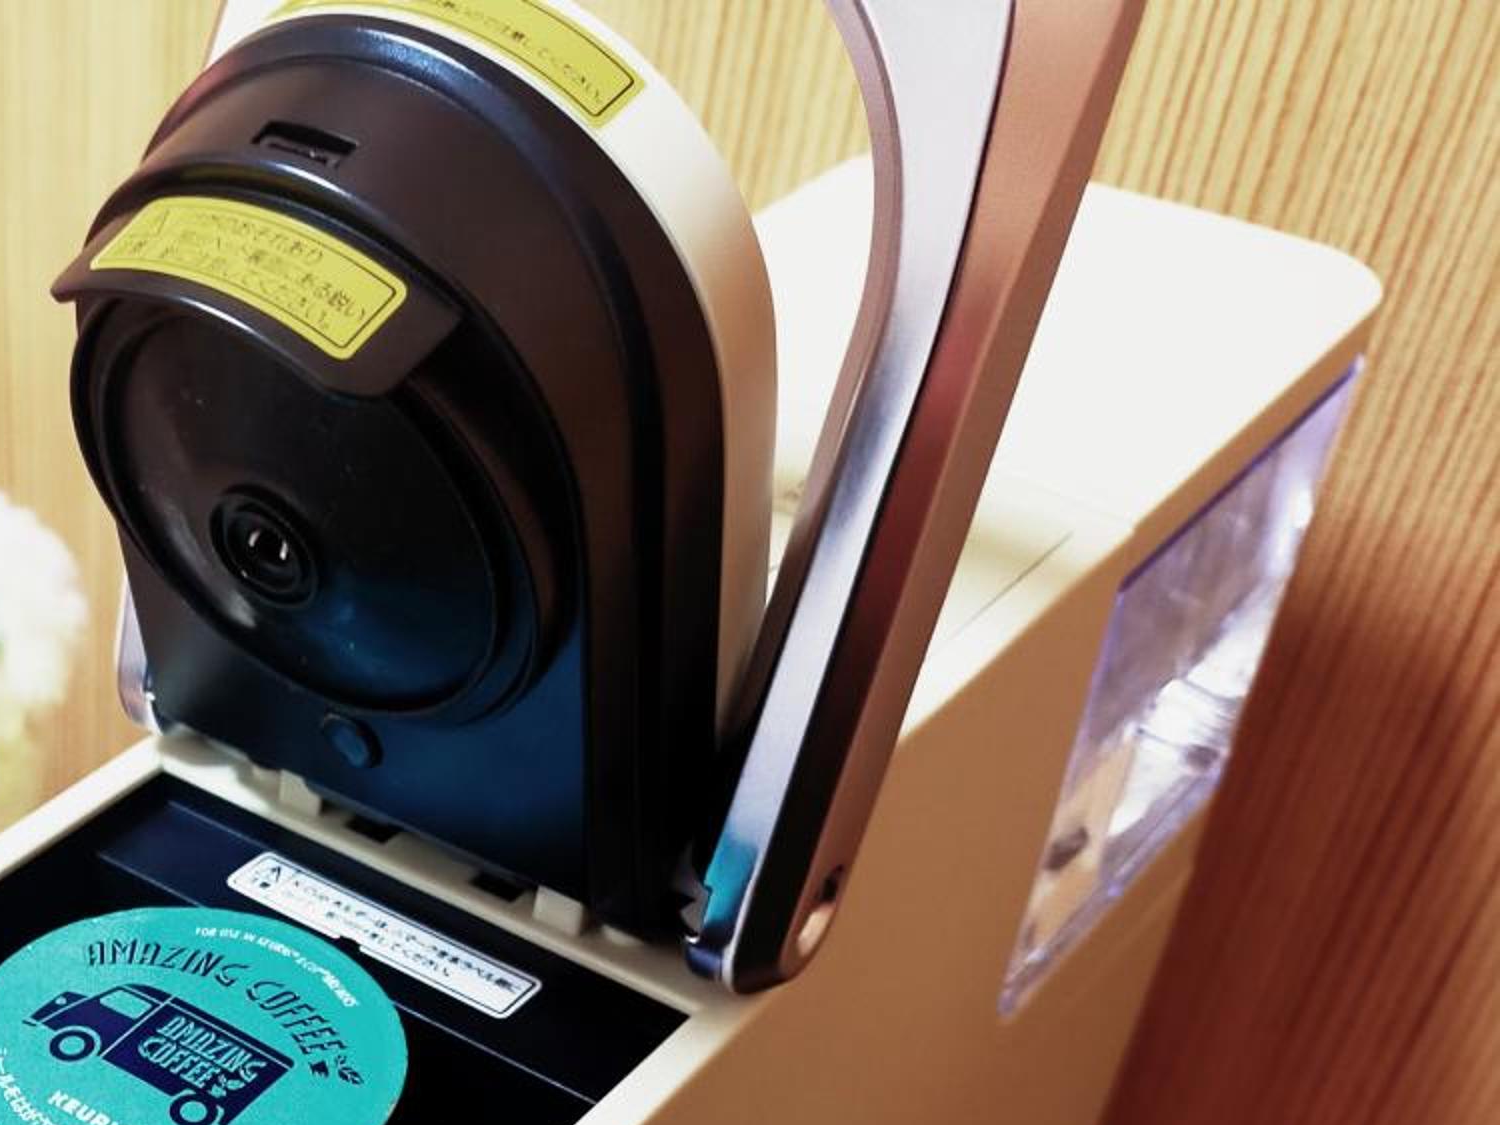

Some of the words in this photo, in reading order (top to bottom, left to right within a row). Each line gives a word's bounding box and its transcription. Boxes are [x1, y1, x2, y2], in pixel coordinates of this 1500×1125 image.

[86, 938, 249, 987] AMAZING
[245, 980, 348, 1054] COFFEE
[137, 1035, 220, 1090] COFFEE
[156, 1014, 267, 1082] AMAZING
